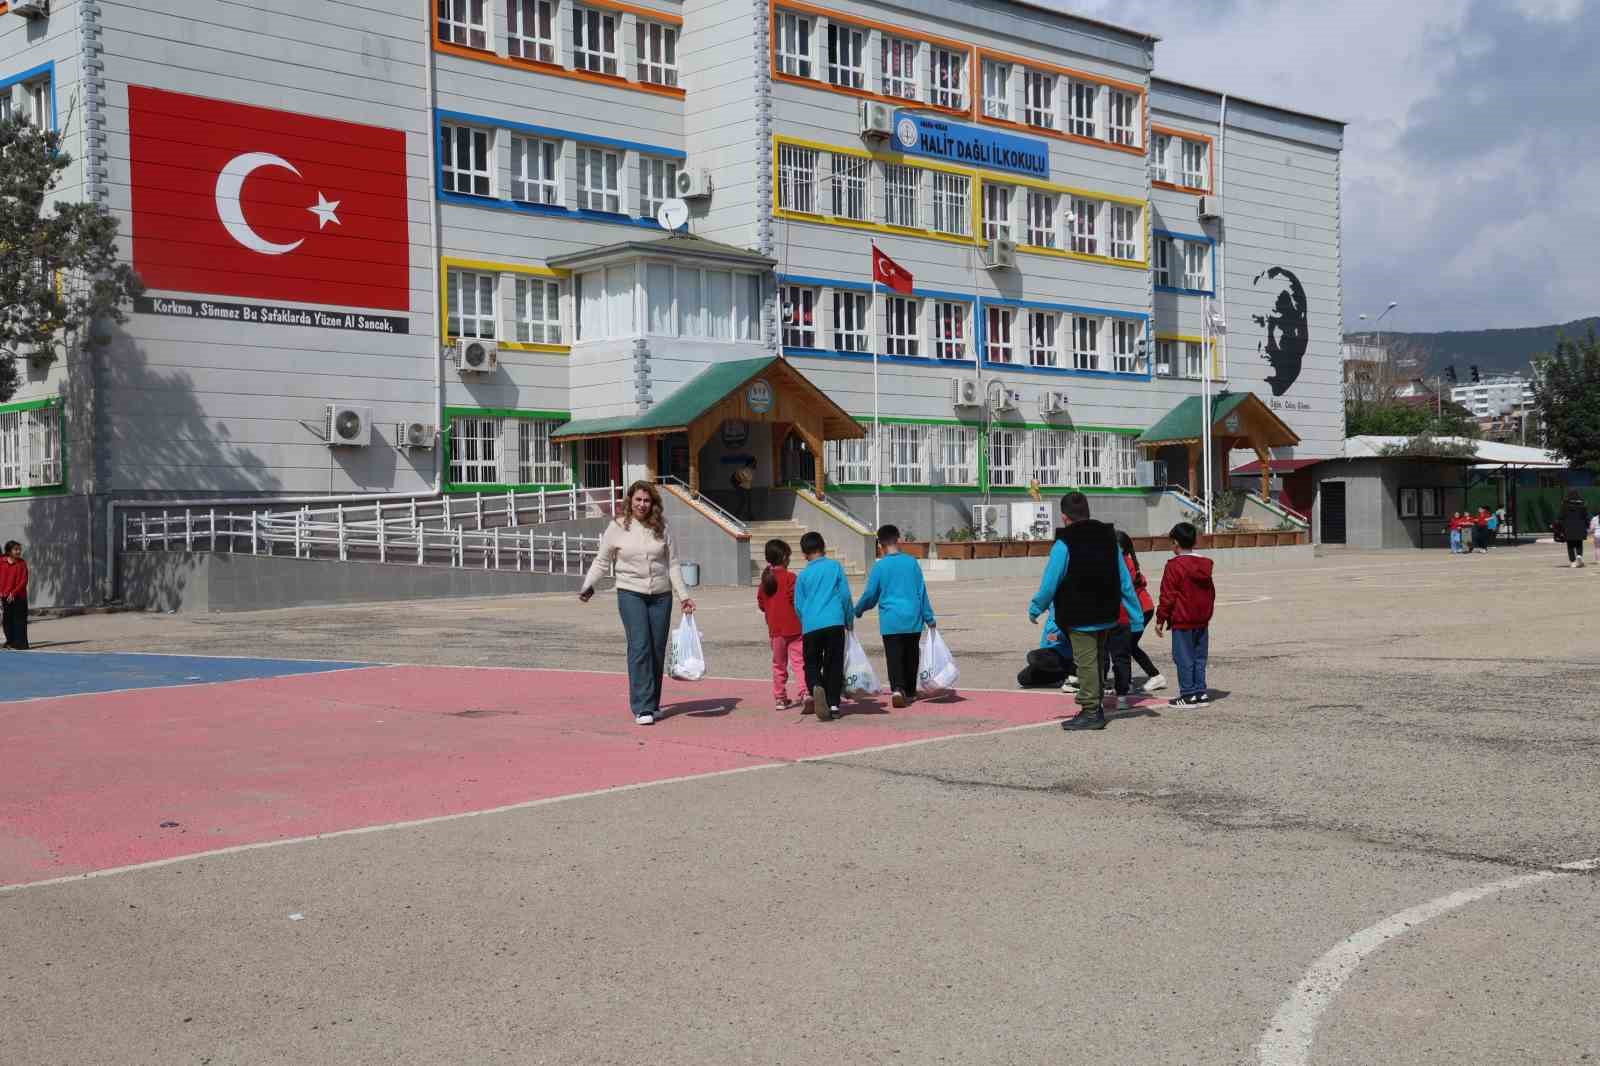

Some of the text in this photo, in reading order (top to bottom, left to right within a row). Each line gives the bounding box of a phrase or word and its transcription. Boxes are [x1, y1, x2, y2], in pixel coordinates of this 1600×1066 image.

[921, 133, 1046, 172] HALİT DAĞLI İLKOKULU
[243, 307, 257, 320] Bu
[314, 312, 341, 327] Yüzen
[345, 315, 355, 328] Al
